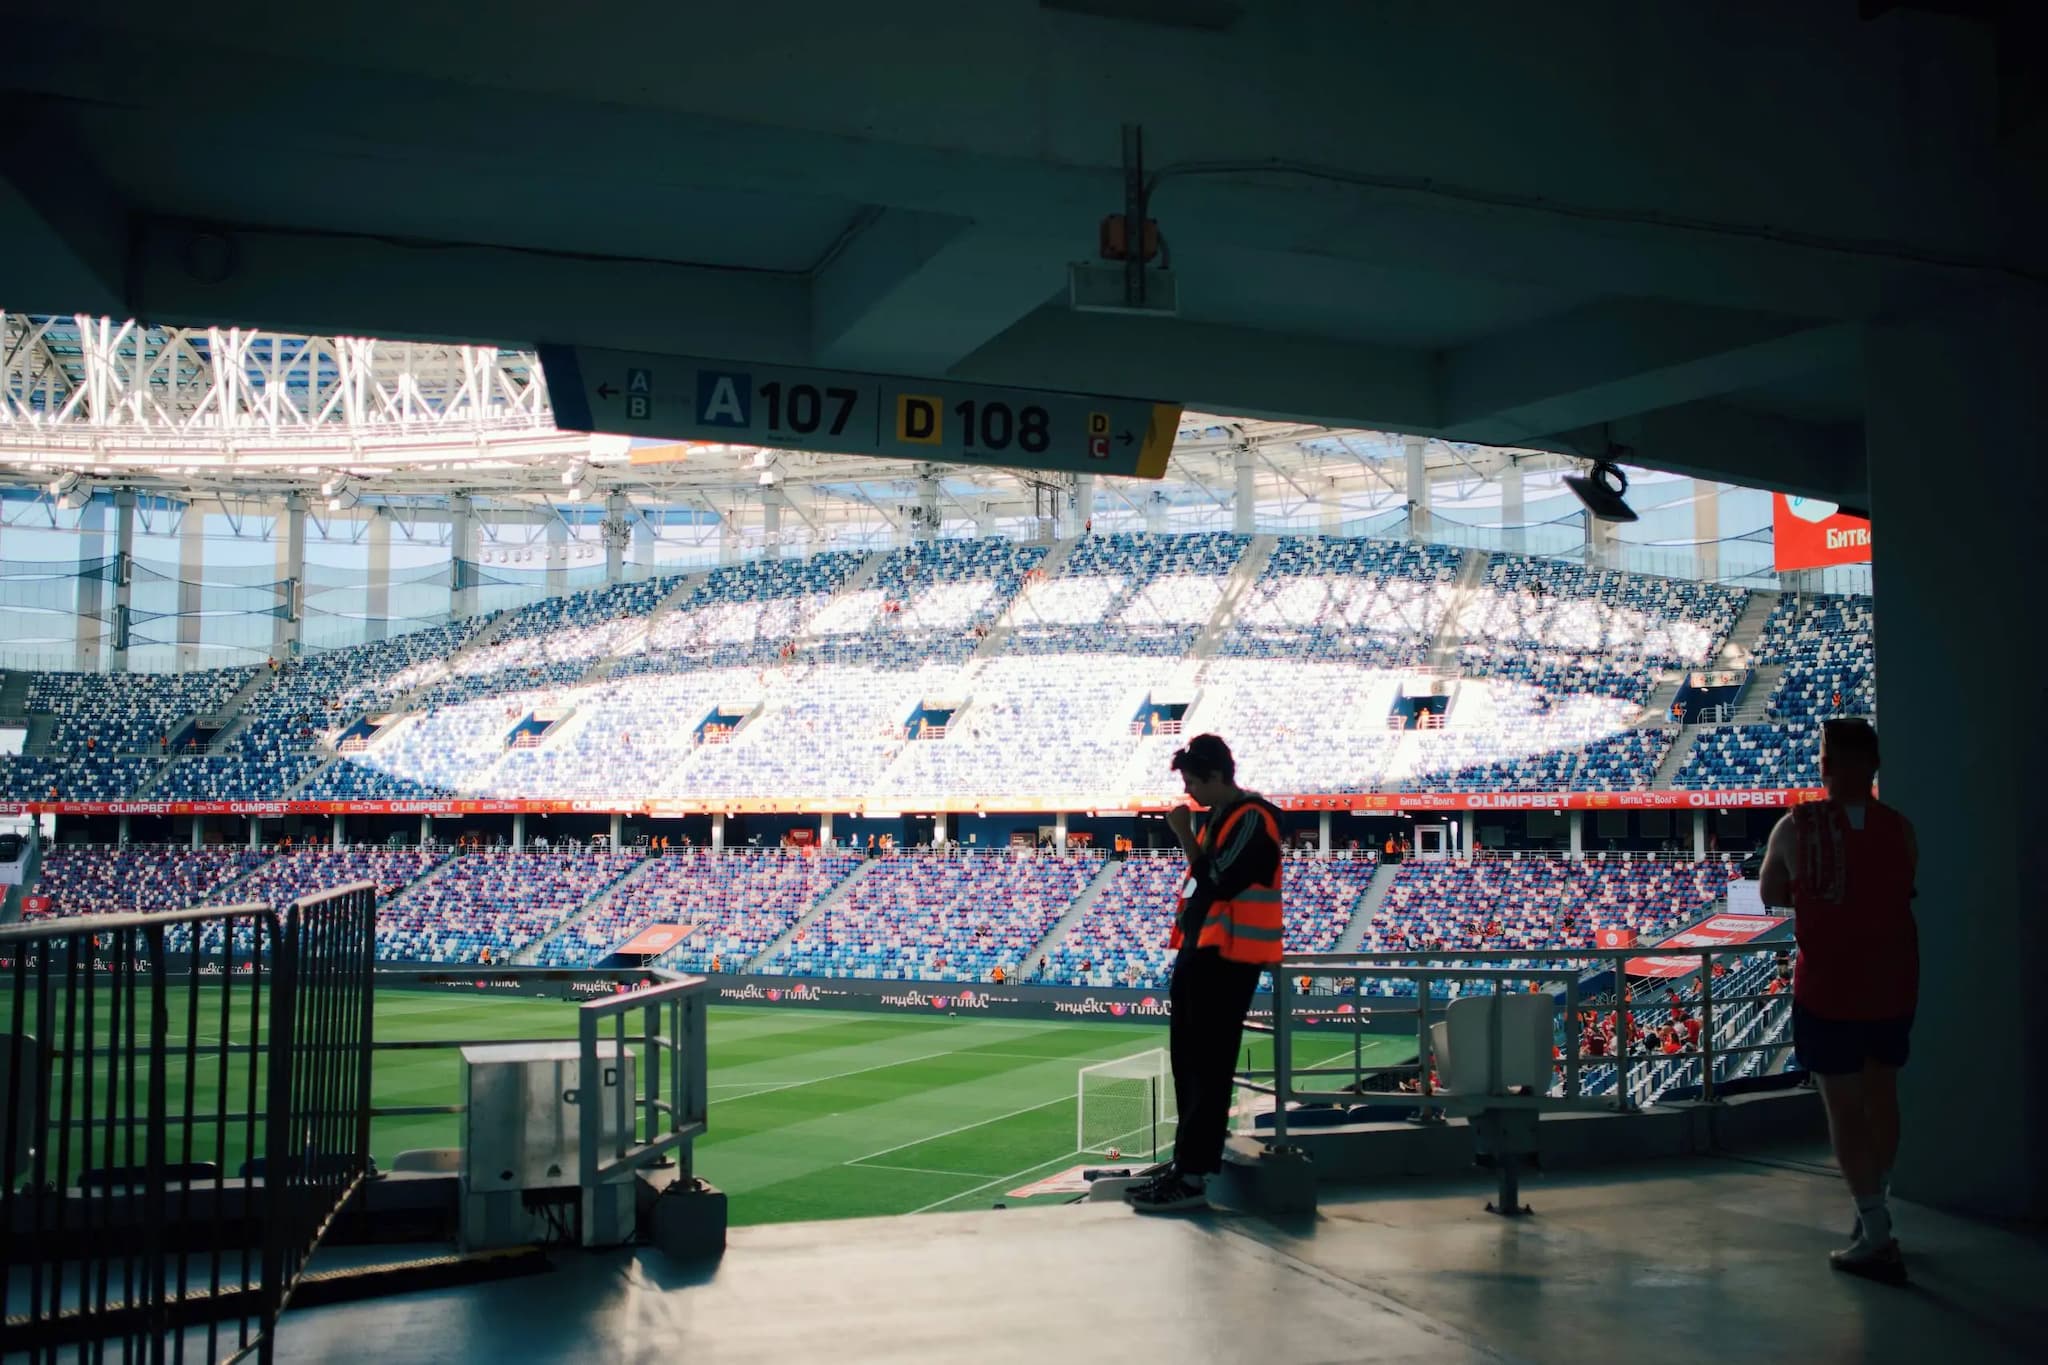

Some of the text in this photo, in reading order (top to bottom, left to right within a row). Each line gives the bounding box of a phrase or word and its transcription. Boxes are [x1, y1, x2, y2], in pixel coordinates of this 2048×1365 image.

[630, 373, 649, 391] A
[631, 398, 648, 418] B
[703, 375, 857, 435] A 107
[905, 399, 1050, 452] D 108
[1092, 414, 1106, 433] D
[1092, 438, 1106, 458] C
[230, 803, 288, 812] OLIMPBET
[390, 802, 454, 812] OLIMPBET
[1466, 795, 1573, 808] OLIMPBET
[1689, 791, 1788, 806] OLIMPBET
[109, 803, 171, 813] OLIMPBET
